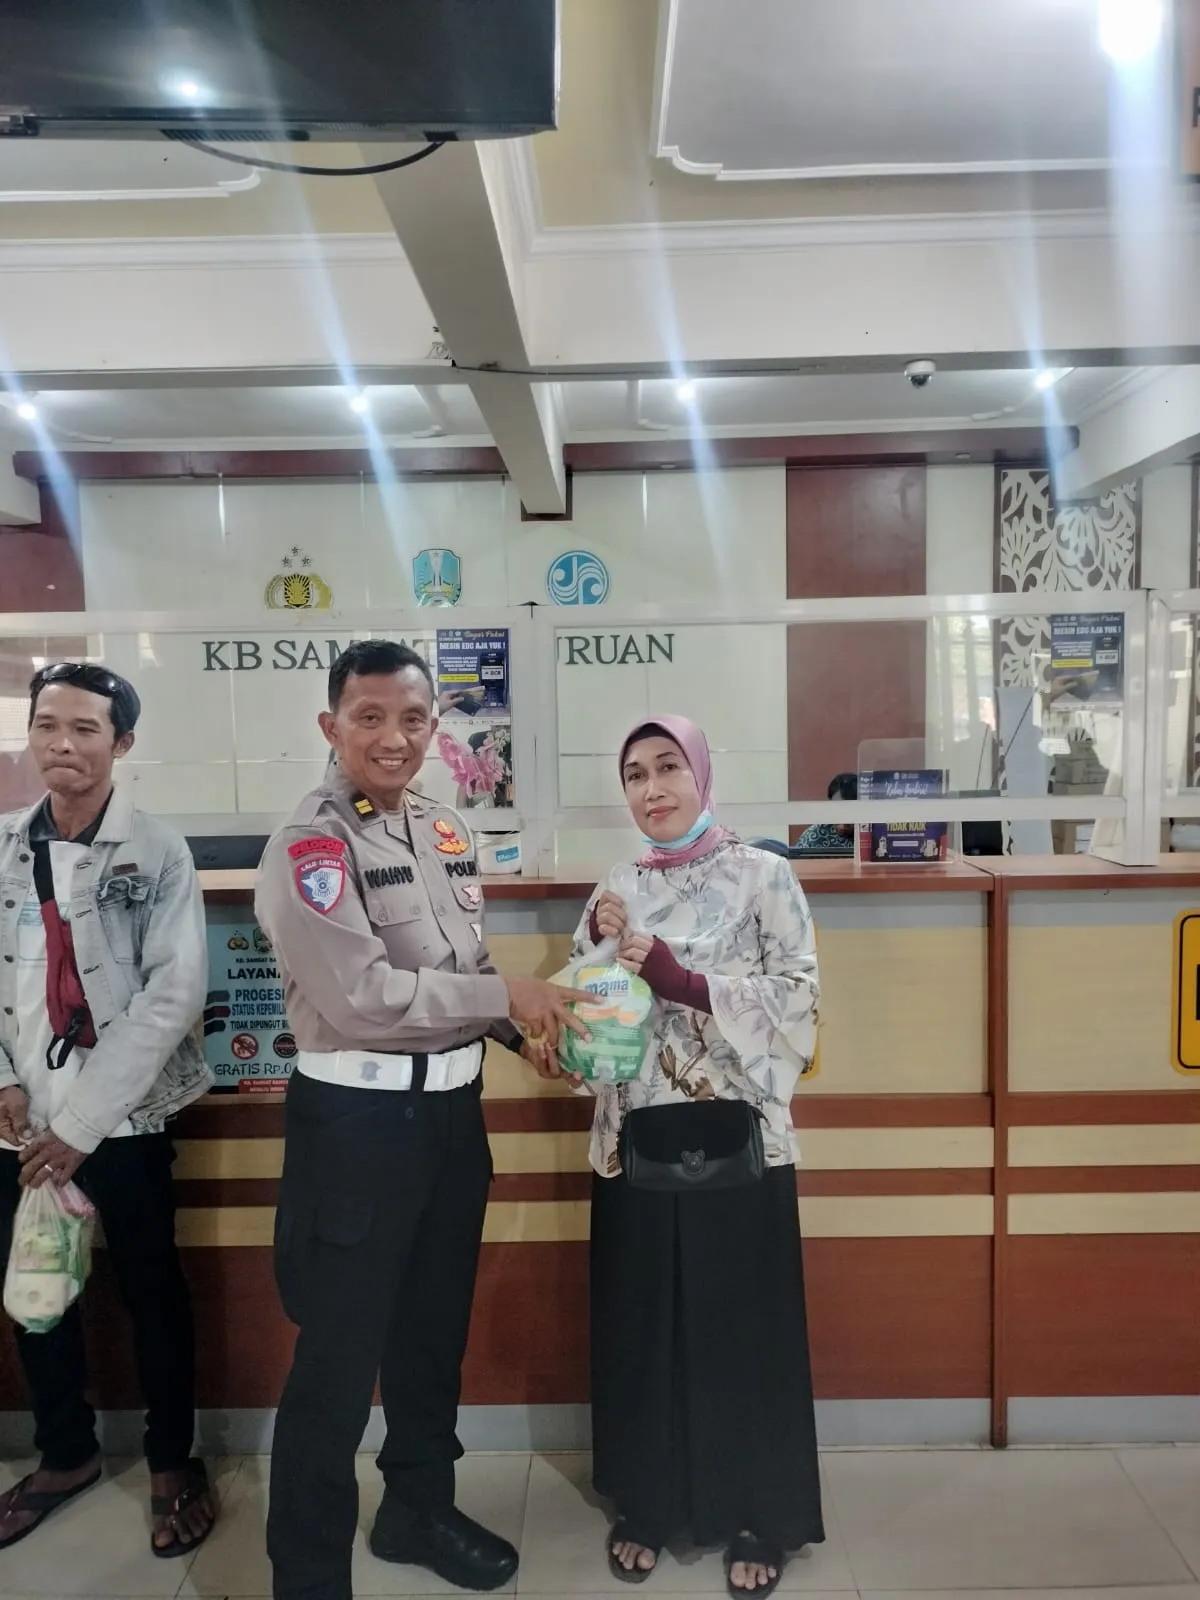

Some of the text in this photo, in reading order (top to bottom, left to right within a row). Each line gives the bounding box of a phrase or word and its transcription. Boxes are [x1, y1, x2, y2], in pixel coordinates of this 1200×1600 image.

[462, 642, 474, 650] EDC
[475, 641, 488, 650] AJA
[489, 641, 502, 650] YUK
[202, 640, 262, 671] KB
[364, 865, 415, 889] WAHYU
[227, 967, 281, 980] LAYAN
[231, 1003, 255, 1016] STATUS
[230, 1019, 249, 1030] TIDAK
[249, 1019, 281, 1030] DIPUNGUT
[214, 1062, 260, 1076] GRATIS
